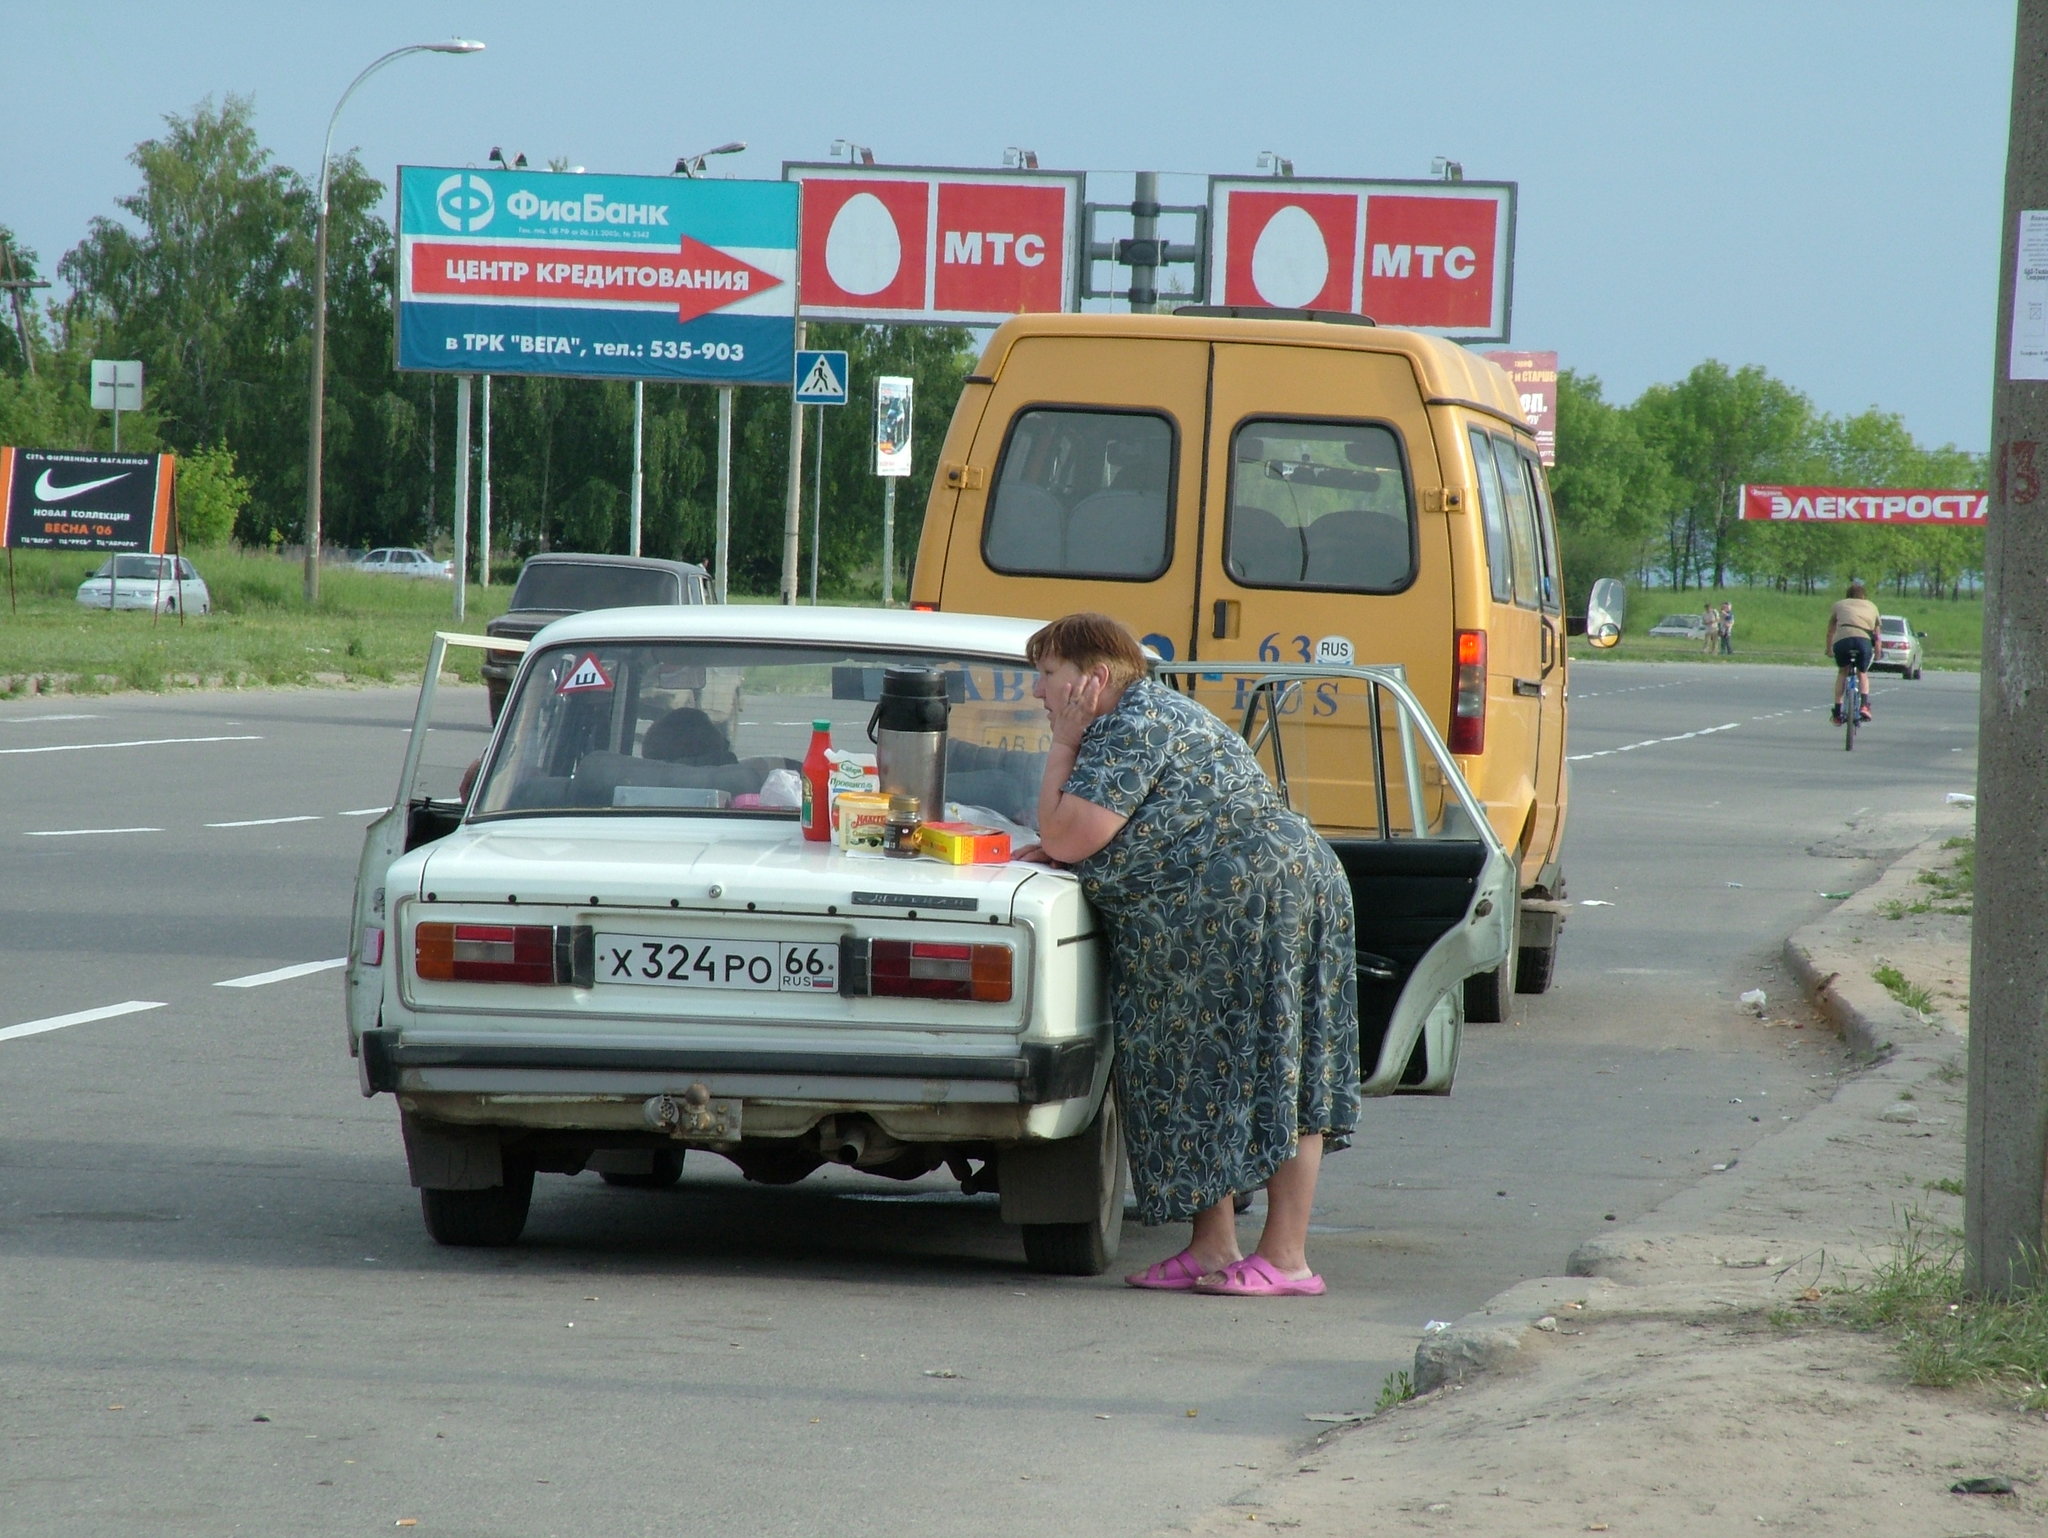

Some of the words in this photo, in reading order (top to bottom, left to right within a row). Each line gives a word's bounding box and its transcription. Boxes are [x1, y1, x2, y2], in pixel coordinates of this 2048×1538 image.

[506, 190, 669, 226] ФиаБанк
[943, 231, 1045, 267] МТС
[1372, 244, 1476, 280] МТС
[446, 259, 529, 283] ЦЕНТР
[536, 262, 749, 291] КРЕДИТОВАНИЯ
[446, 336, 458, 350] в
[463, 334, 505, 352] ТРК
[511, 335, 588, 358] "ВЕГА",
[593, 343, 644, 357] тел.:
[650, 340, 745, 362] 535-903
[25, 453, 44, 461] СЕТЬ
[46, 454, 98, 464] ФИРМЕННЫХ
[100, 457, 149, 465] МАГАЗИНОВ
[33, 508, 67, 518] НОВАЯ
[71, 509, 131, 521] КОЛЛЕКЦИЯ
[44, 523, 88, 534] ВЕСНА
[1320, 642, 1349, 657] RUS
[575, 672, 597, 686] Ш
[785, 947, 824, 975] 66
[782, 975, 811, 987] RUS
